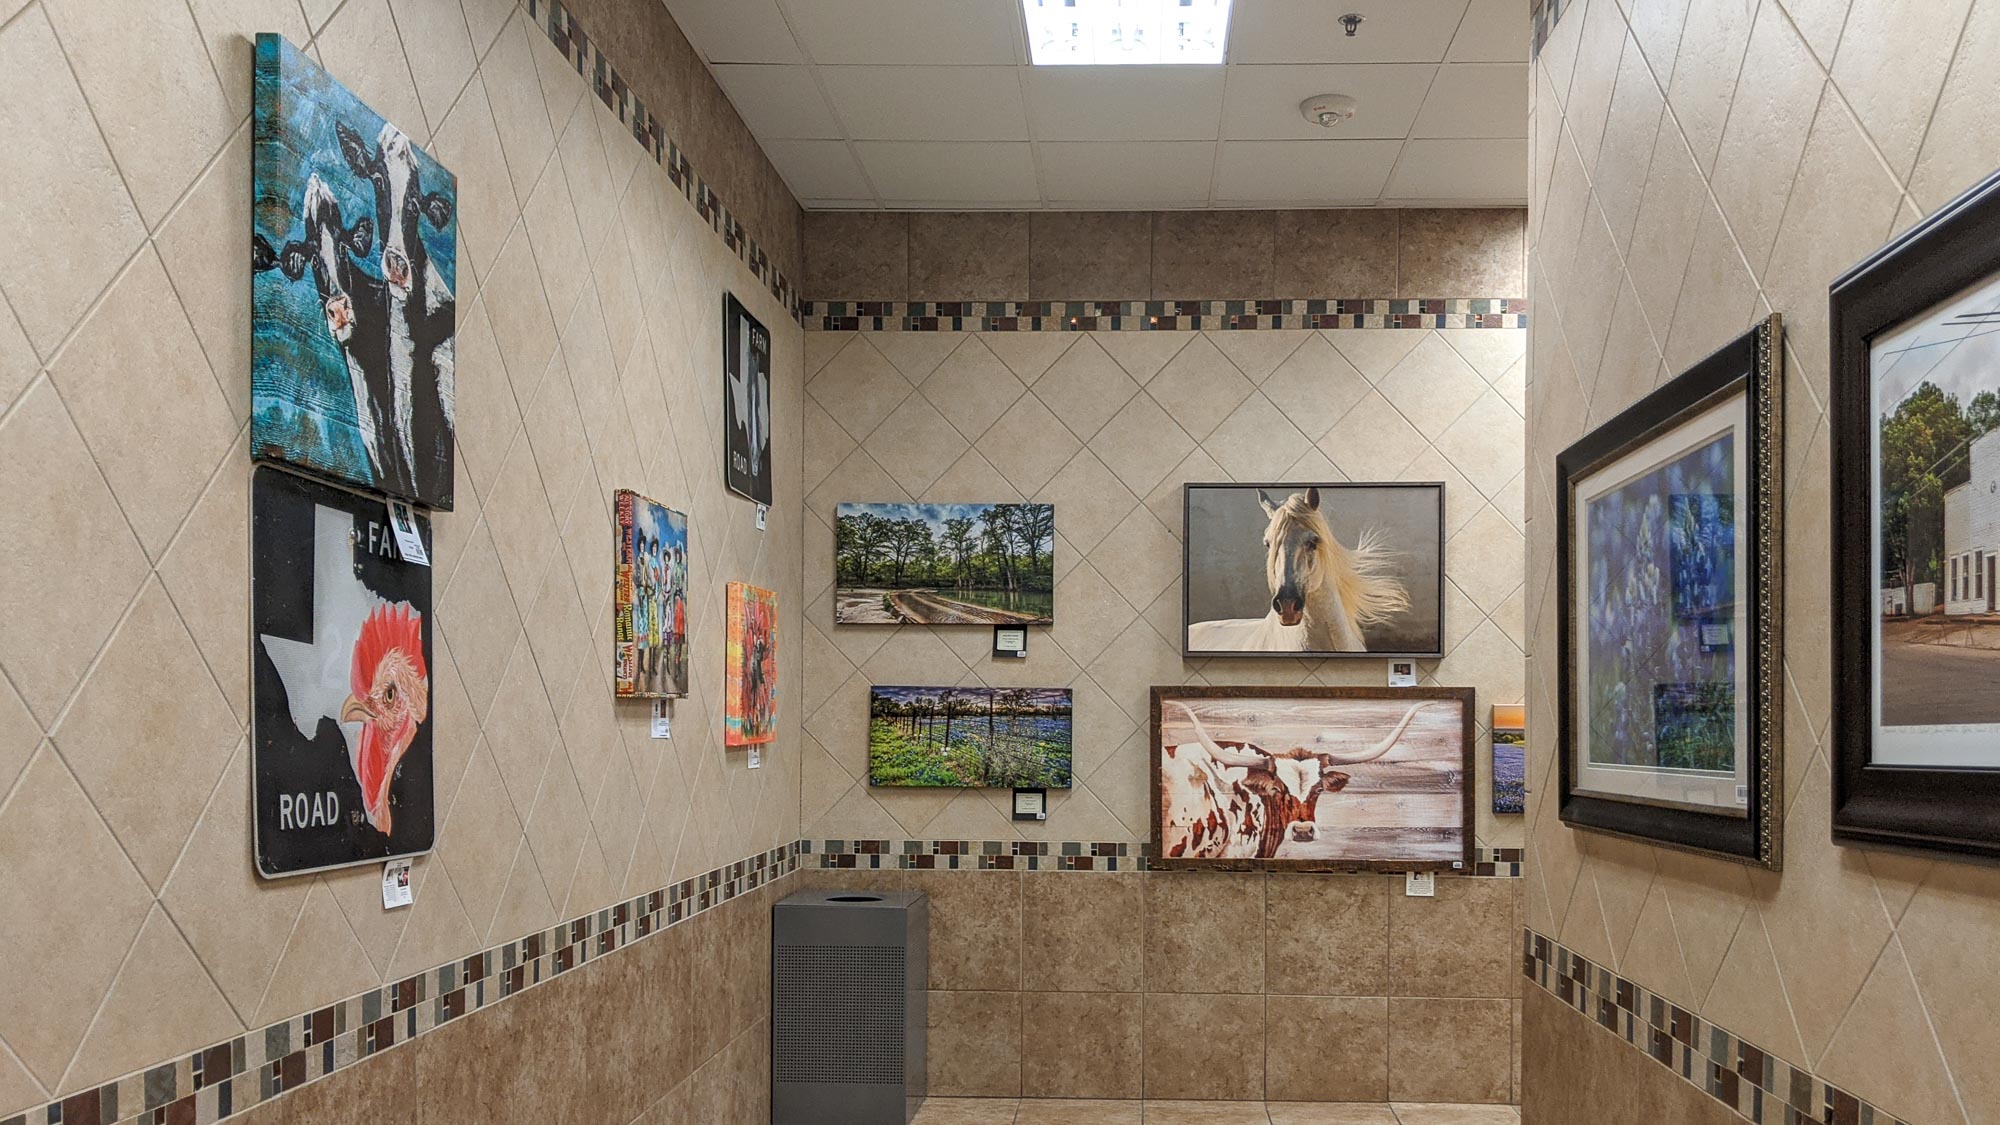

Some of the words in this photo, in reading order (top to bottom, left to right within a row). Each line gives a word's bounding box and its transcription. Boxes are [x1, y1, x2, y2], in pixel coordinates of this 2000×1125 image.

[752, 328, 767, 354] FARM
[733, 451, 748, 474] ROAD
[368, 521, 404, 560] FA
[279, 791, 340, 831] ROAD
